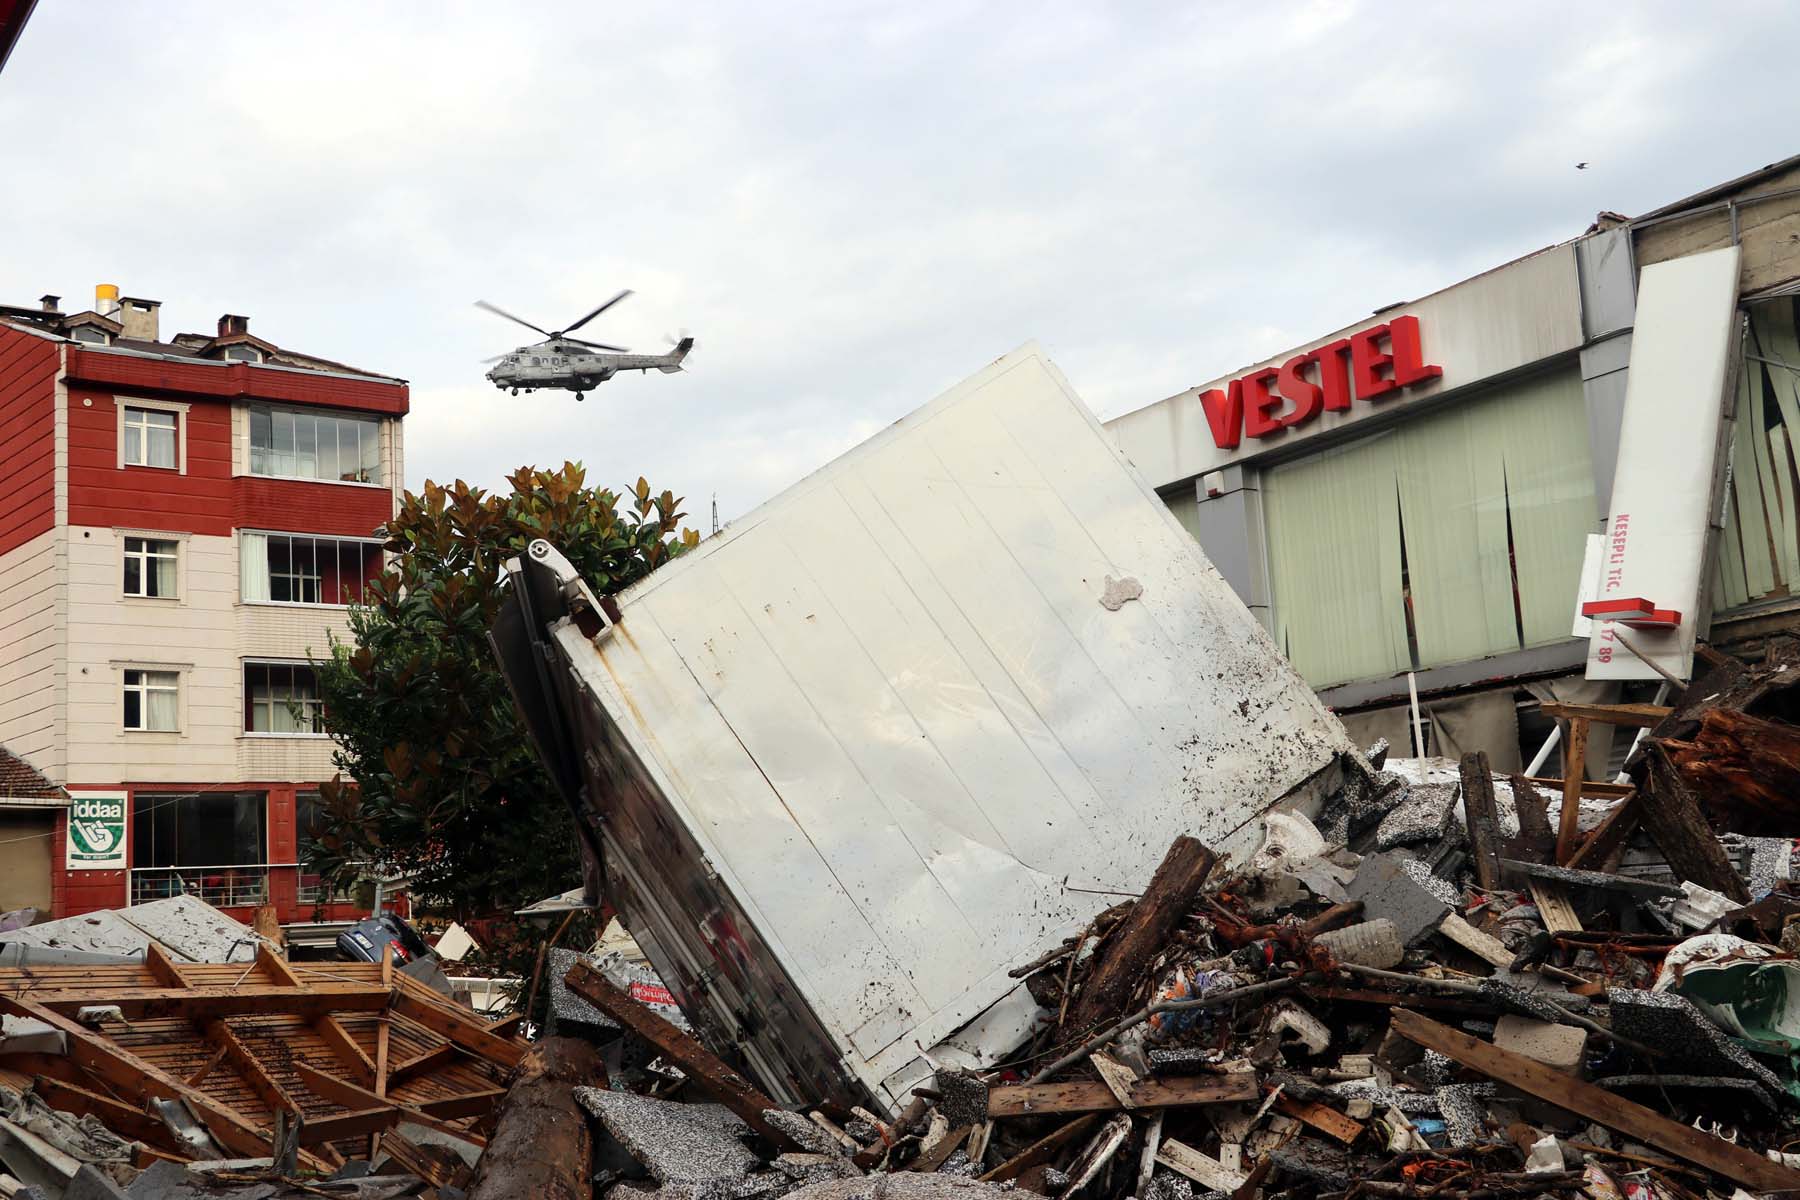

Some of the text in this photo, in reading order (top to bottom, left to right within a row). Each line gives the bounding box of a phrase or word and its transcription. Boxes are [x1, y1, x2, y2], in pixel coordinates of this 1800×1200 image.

[1199, 315, 1443, 449] VESTEL
[1599, 647, 1613, 664] 89
[73, 800, 121, 818] iddaa
